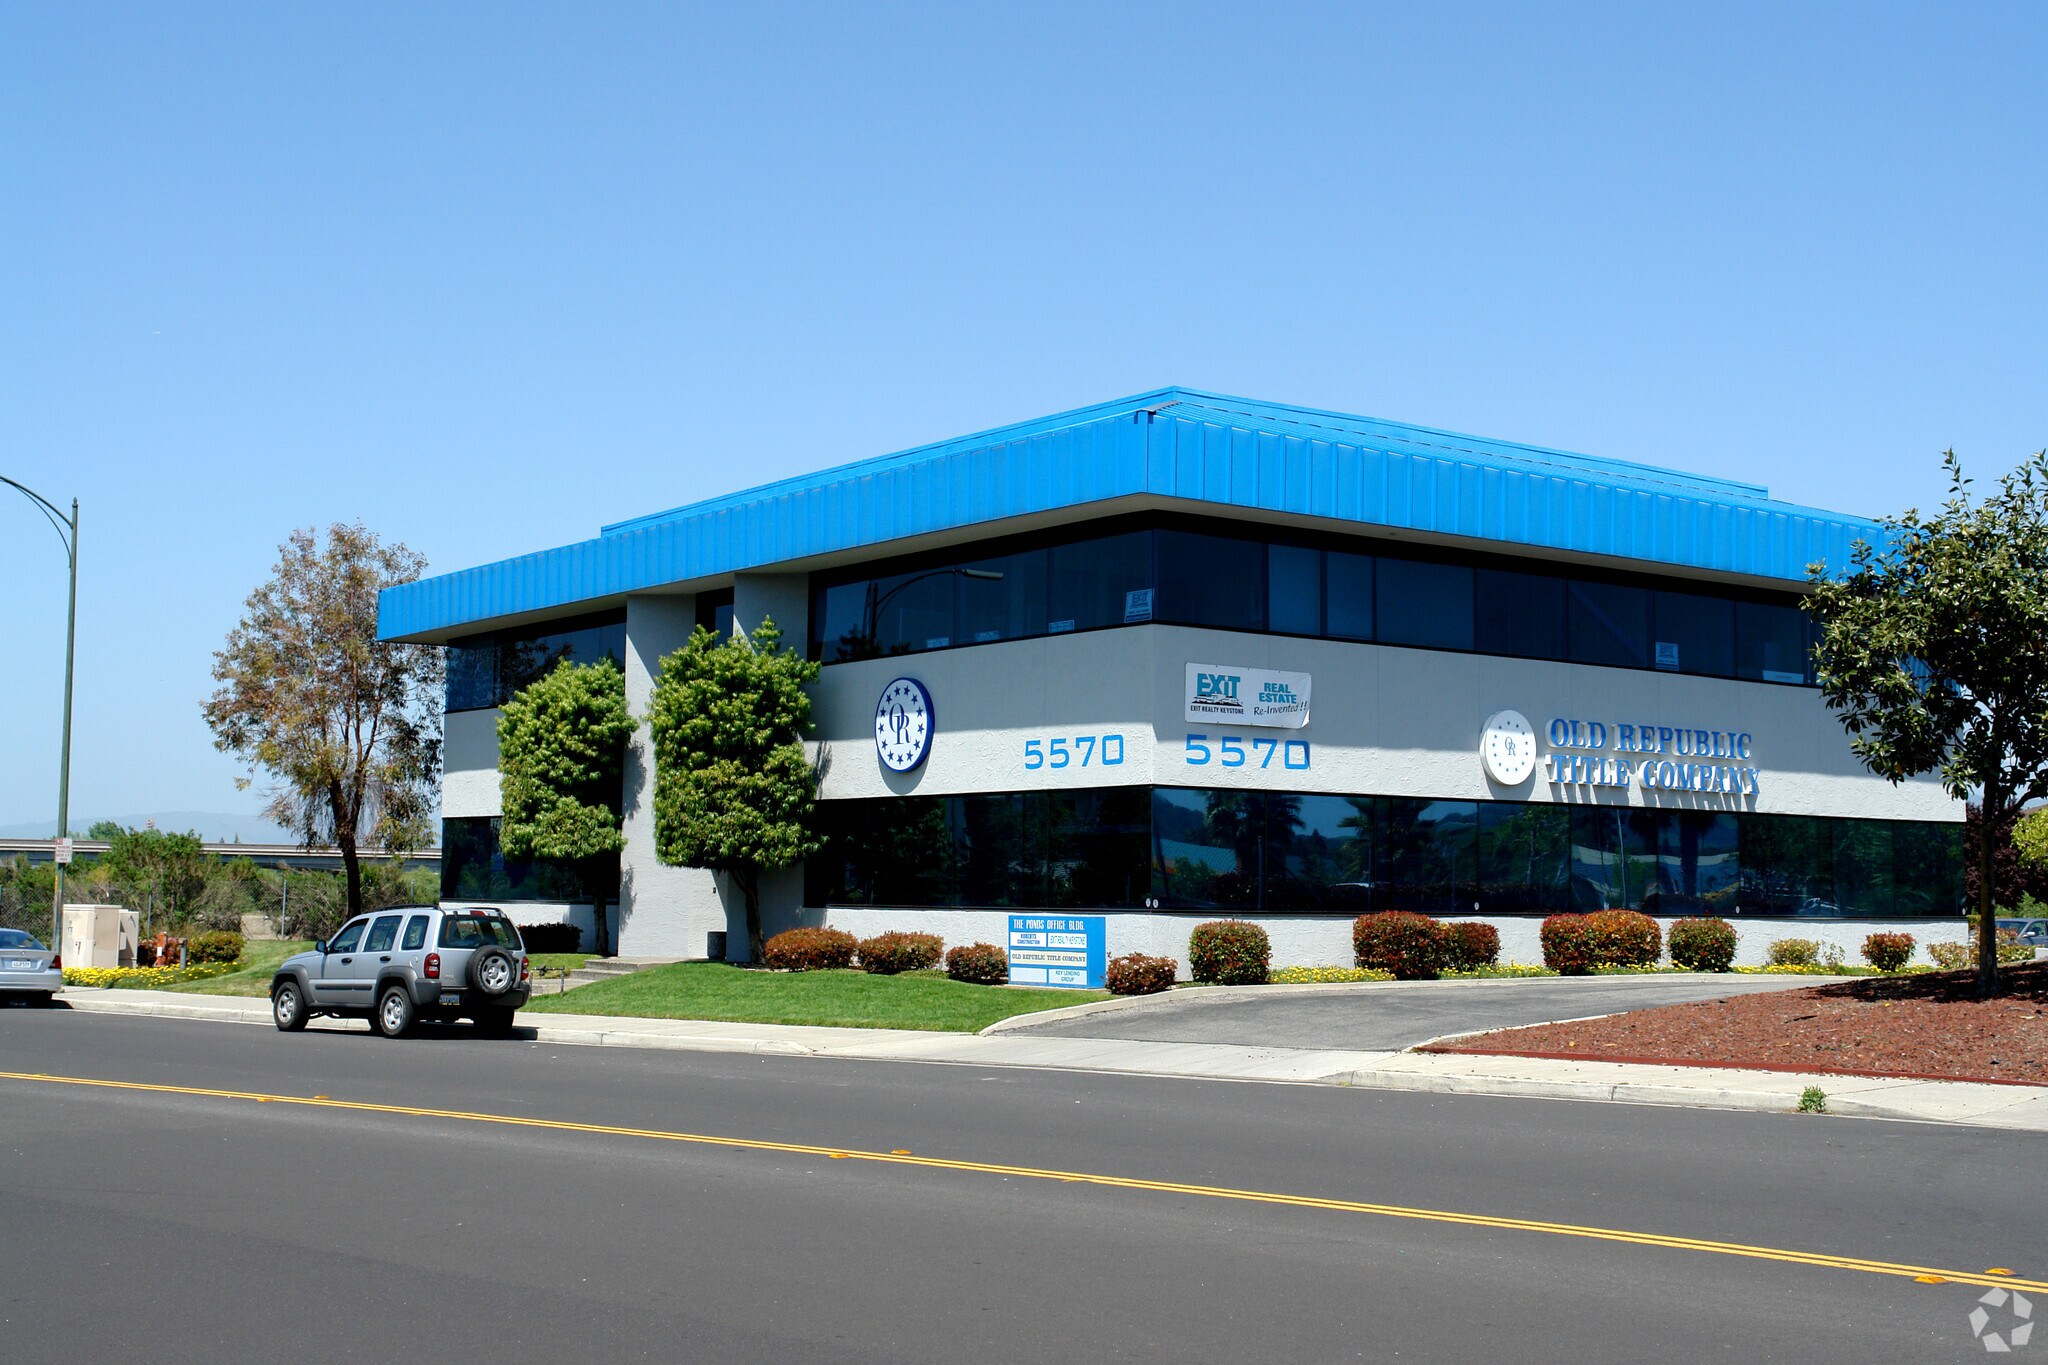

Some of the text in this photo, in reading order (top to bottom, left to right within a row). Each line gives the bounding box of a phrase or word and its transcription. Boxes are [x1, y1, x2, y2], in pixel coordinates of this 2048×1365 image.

[1259, 692, 1297, 704] ESTATE
[1264, 682, 1292, 694] REAL
[1220, 707, 1244, 715] KEYSTONE
[1548, 718, 1752, 760] OLD REPUBLIC
[1025, 734, 1124, 770] 5570
[1186, 733, 1310, 770] 5570
[1549, 754, 1761, 794] TITLE COMPANY
[1013, 918, 1023, 929] THE
[1026, 919, 1044, 930] PONDS
[1047, 919, 1066, 930] OFFICE
